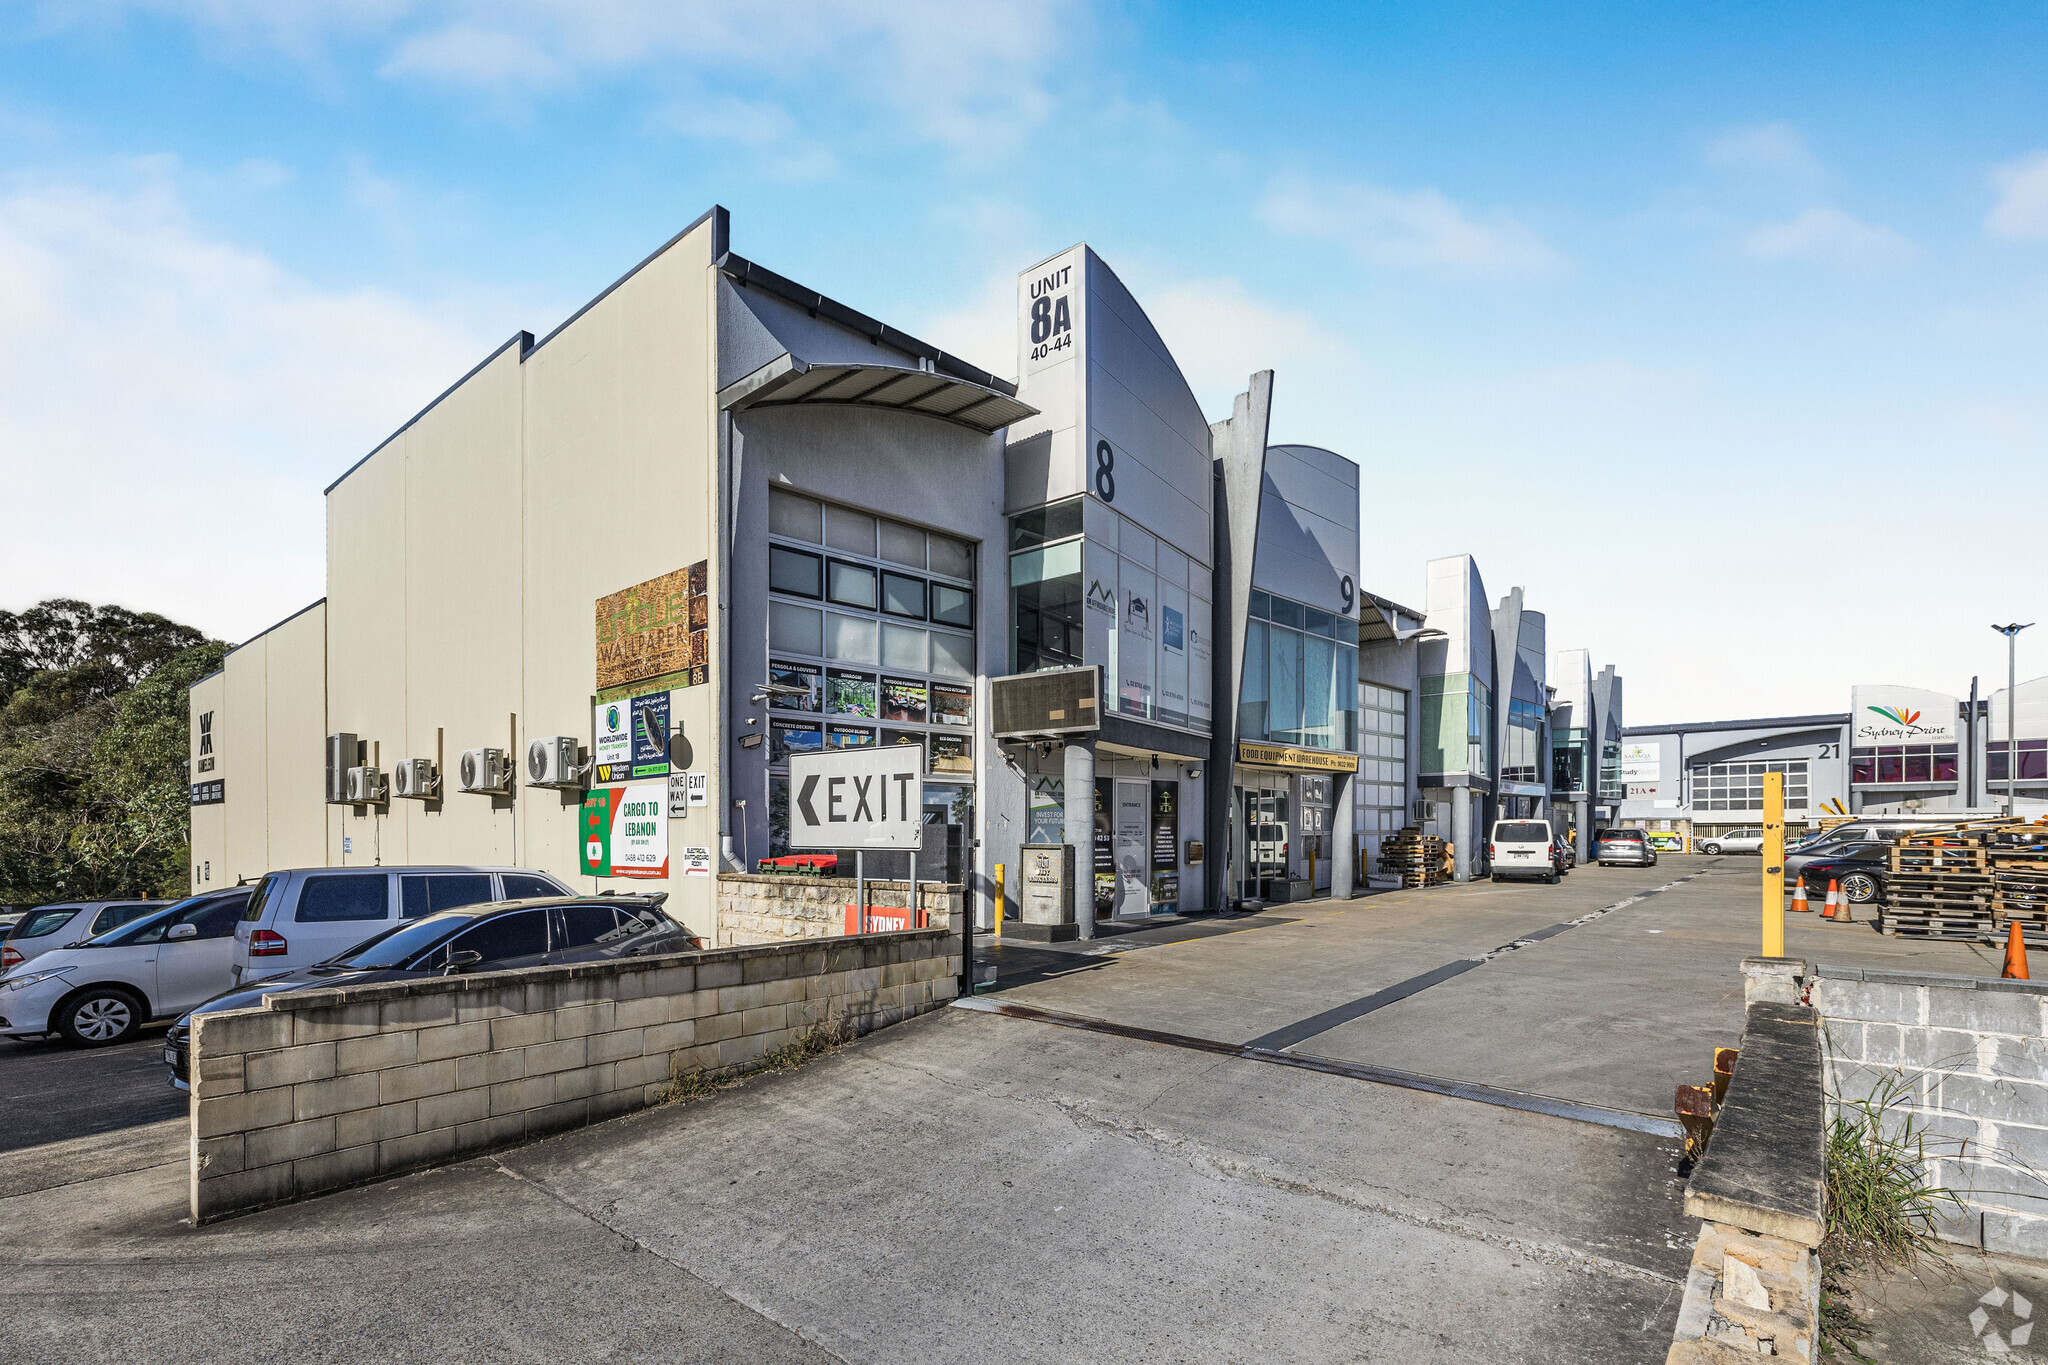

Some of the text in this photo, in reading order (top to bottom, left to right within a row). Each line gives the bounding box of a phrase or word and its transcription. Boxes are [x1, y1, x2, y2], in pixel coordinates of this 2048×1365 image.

[1030, 265, 1072, 299] UNIT
[1030, 295, 1072, 345] 8A
[1030, 333, 1072, 361] 40-44
[1096, 439, 1115, 503] 8
[1340, 575, 1355, 615] 9
[600, 624, 685, 665] WALLPAPER
[625, 667, 642, 682] OPEN
[644, 662, 661, 677] NOW
[771, 662, 792, 671] PERGOLA
[797, 667, 818, 675] LOUVERS
[692, 673, 704, 686] 8B
[598, 733, 628, 744] WORLDWIDE
[1858, 723, 1946, 740] Sydney Print
[598, 744, 610, 752] MONEY
[1818, 743, 1841, 760] 21
[1242, 748, 1259, 759] FOOD
[1260, 750, 1296, 762] EQUIPMENT
[1296, 754, 1328, 766] WAREHOUSE
[612, 764, 630, 772] Western
[671, 777, 684, 788] ONE
[689, 776, 706, 789] EXIT
[598, 797, 605, 807] 18
[670, 791, 685, 802] WAY
[828, 773, 914, 823] EXIT
[623, 801, 658, 818] CARGO TO
[625, 822, 656, 837] LEBANON
[625, 854, 657, 863] 0458 412 629
[865, 915, 906, 933] SYDNEY
